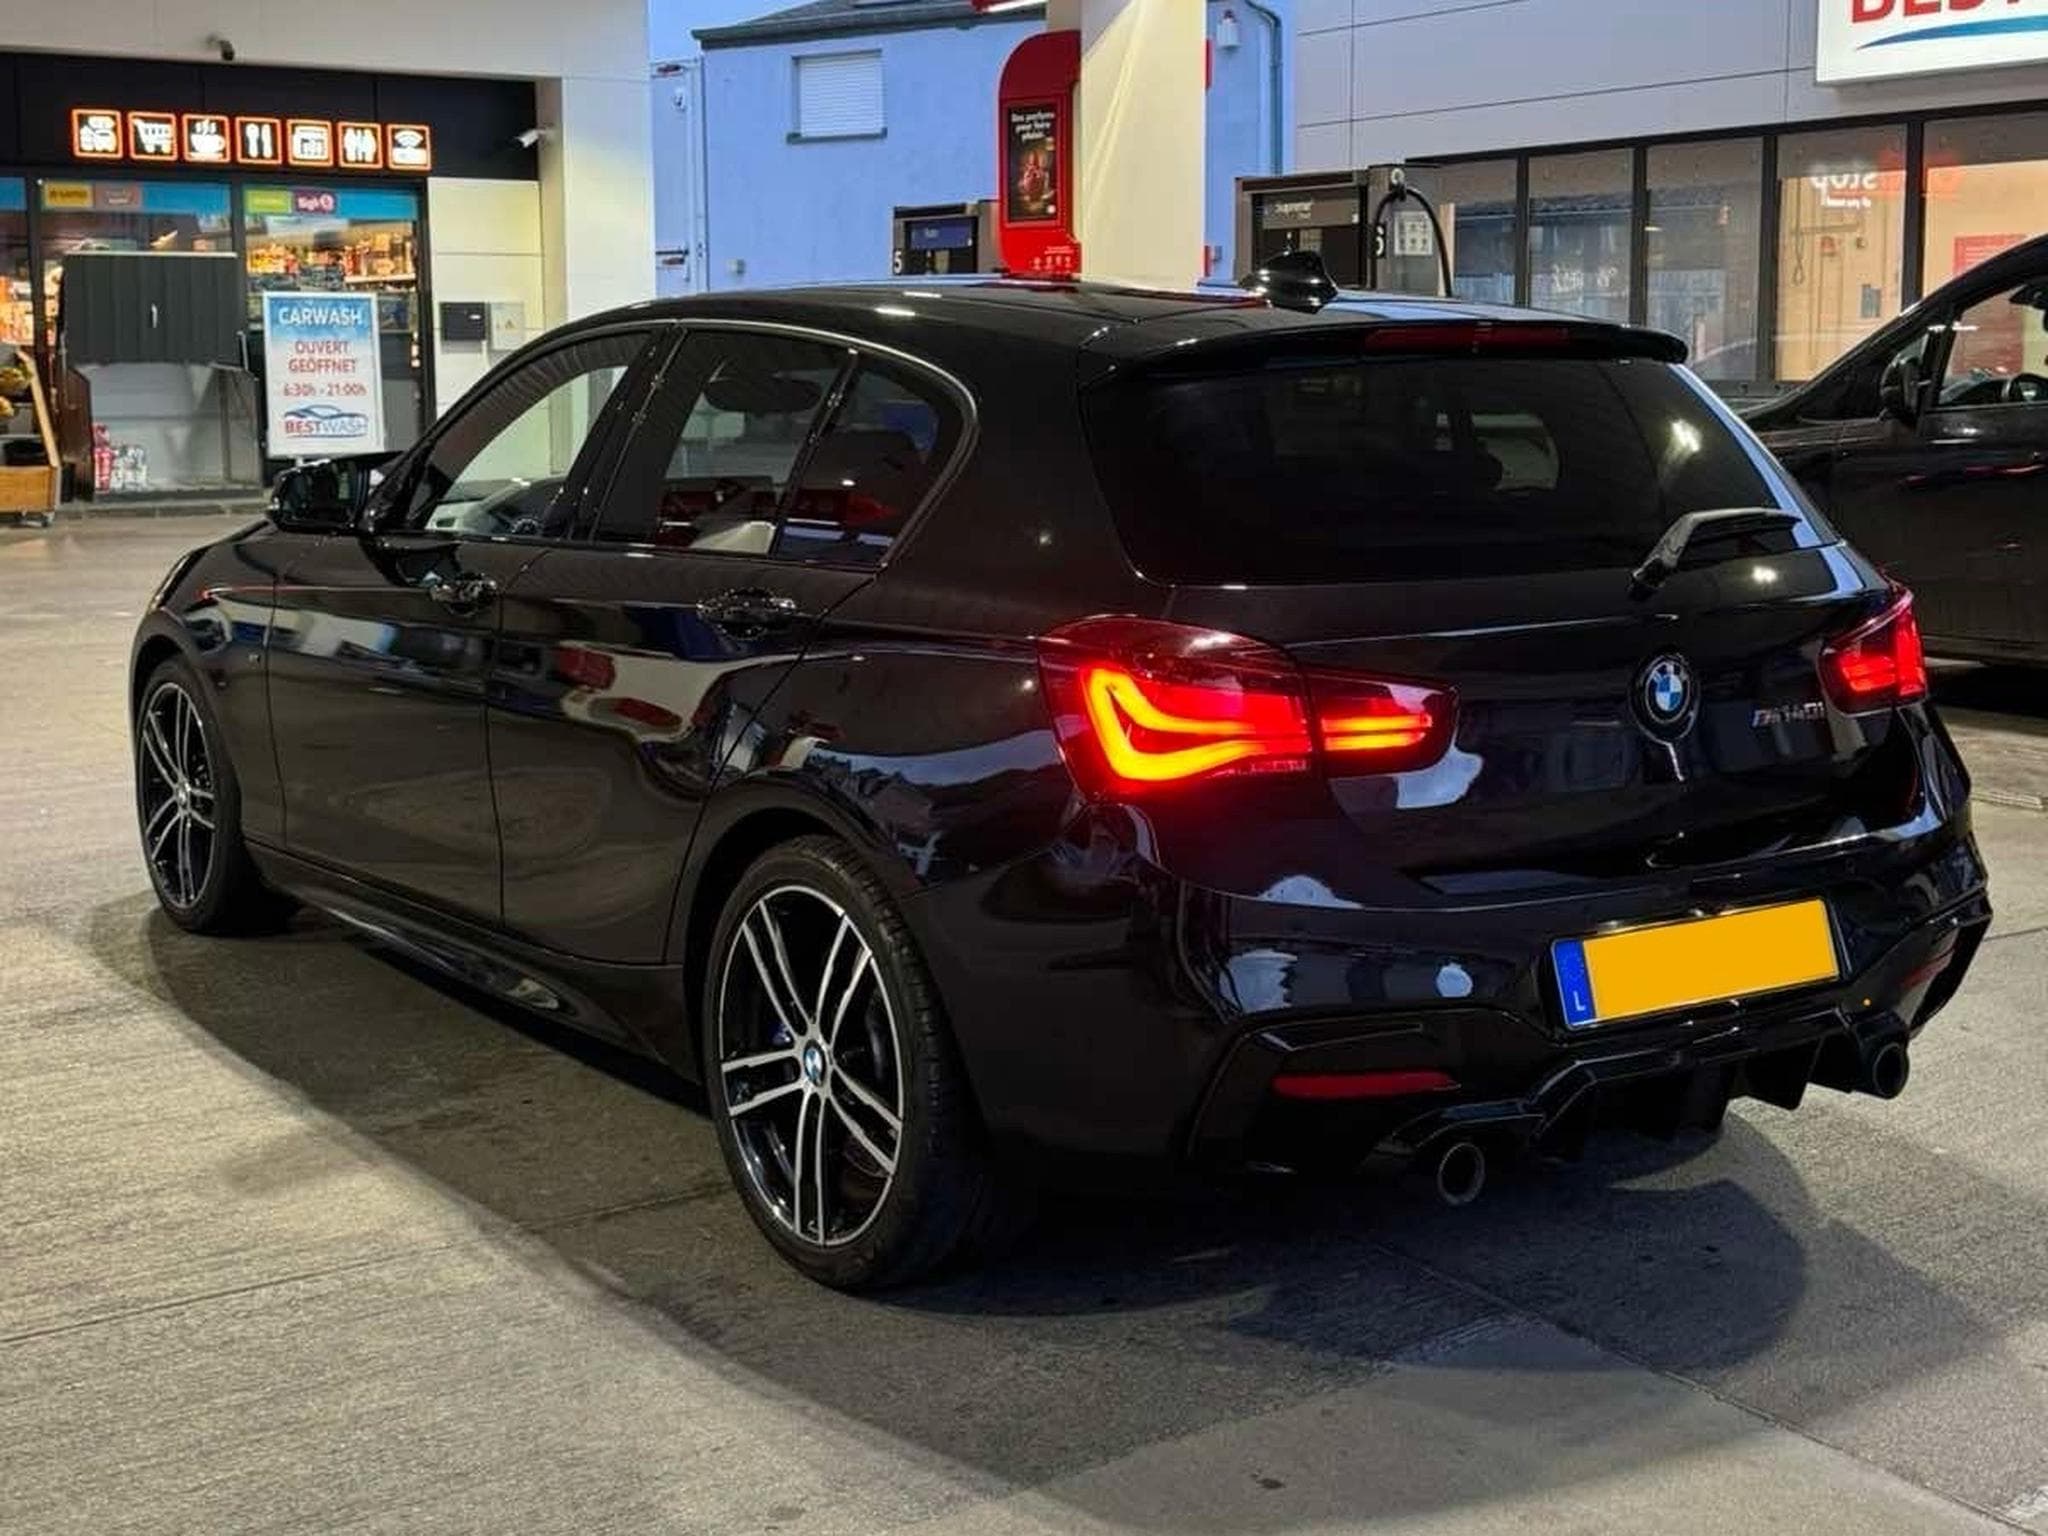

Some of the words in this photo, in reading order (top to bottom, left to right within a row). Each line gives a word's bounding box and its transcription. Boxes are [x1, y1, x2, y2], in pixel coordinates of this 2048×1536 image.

[893, 251, 903, 273] 5
[278, 307, 363, 326] CARWASH
[295, 340, 350, 354] OUVERT
[285, 418, 368, 434] BESTWASH
[1573, 990, 1587, 1011] L
